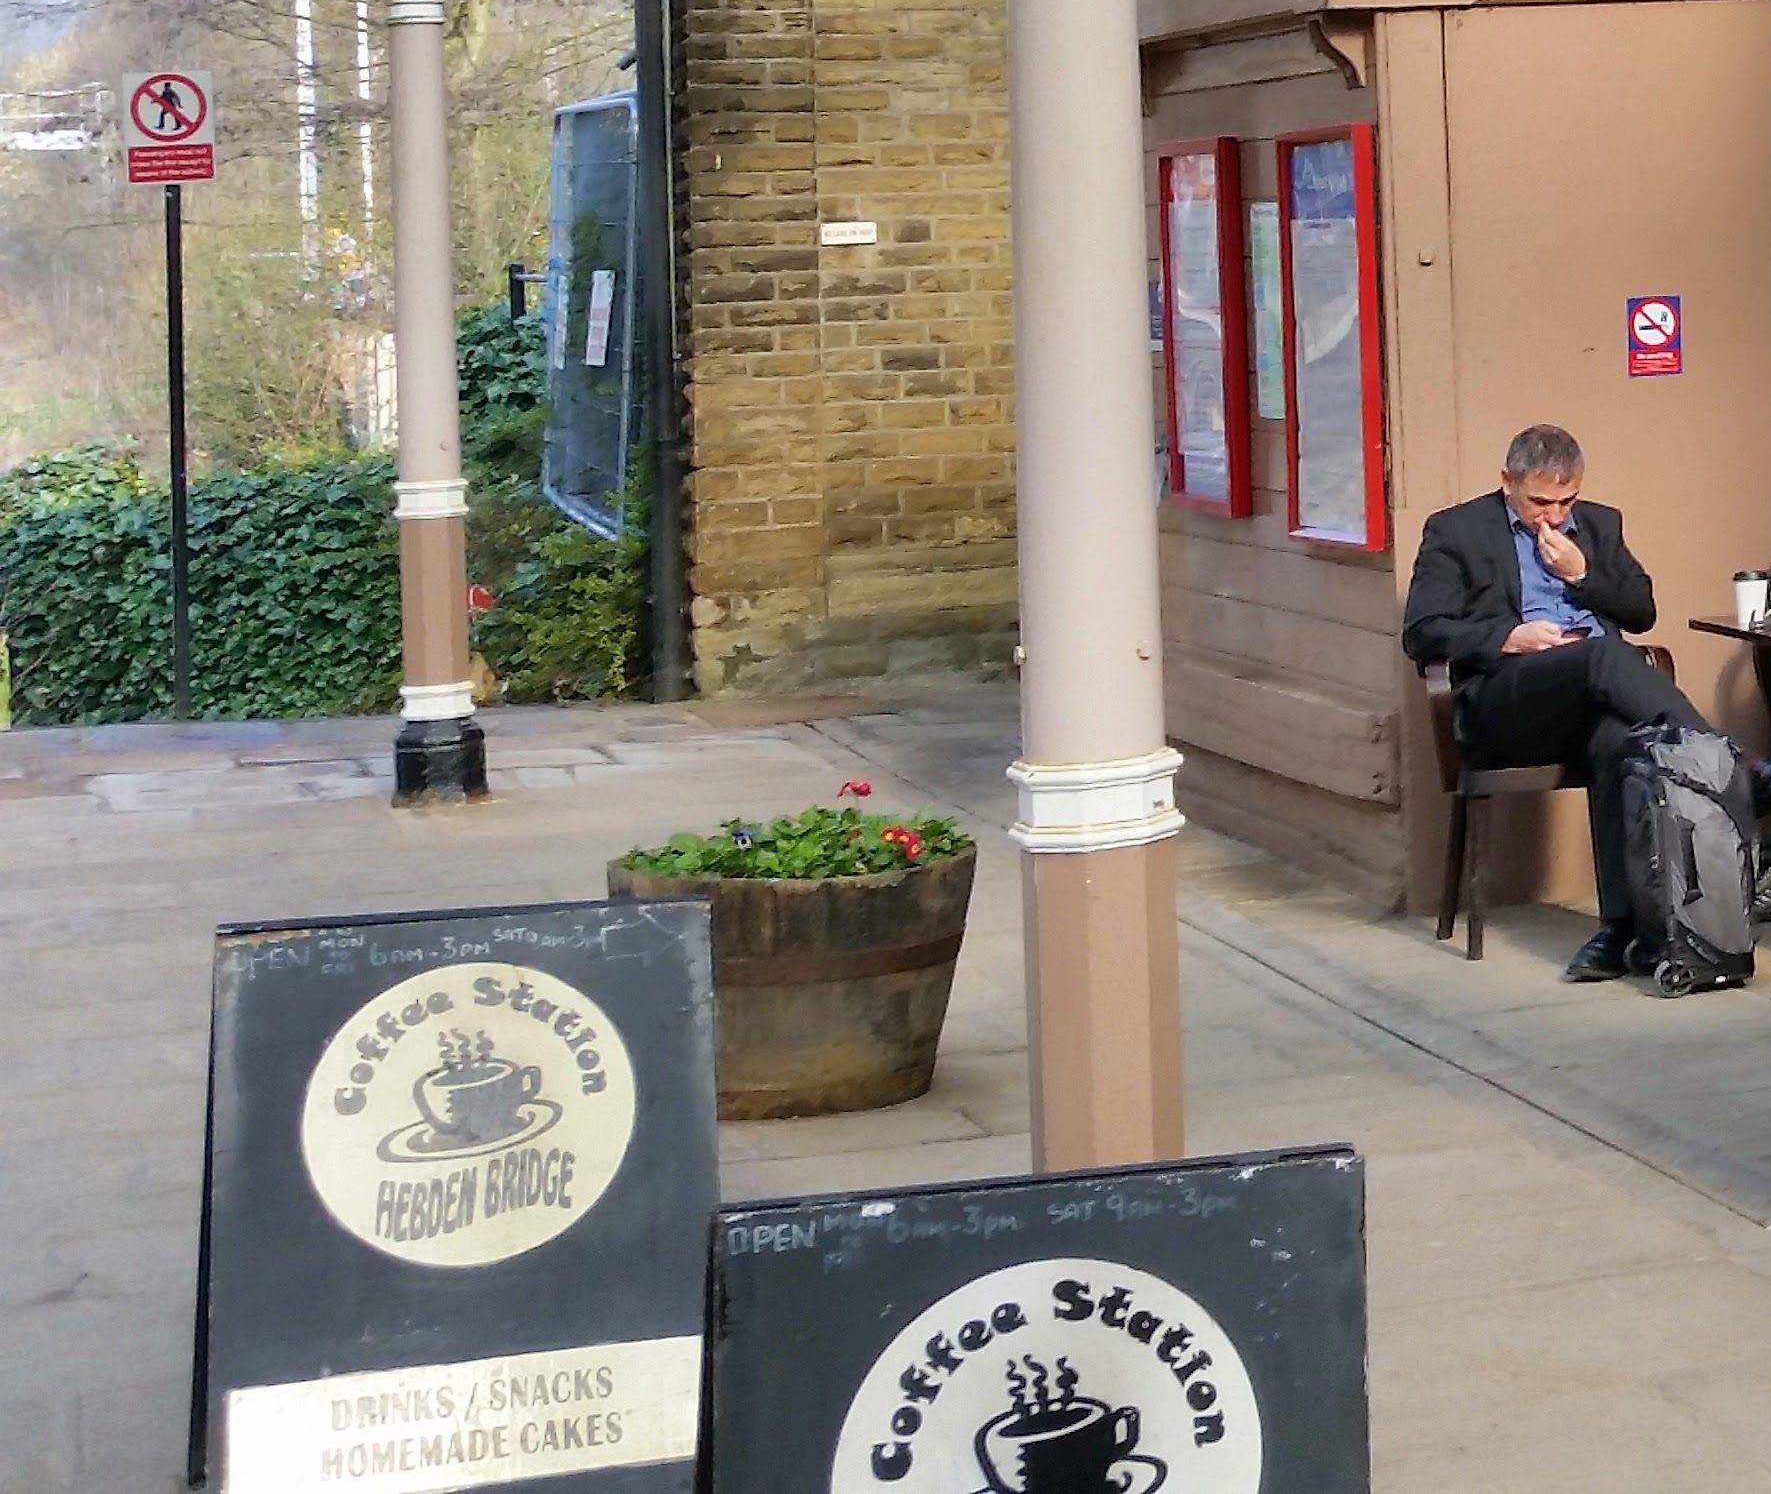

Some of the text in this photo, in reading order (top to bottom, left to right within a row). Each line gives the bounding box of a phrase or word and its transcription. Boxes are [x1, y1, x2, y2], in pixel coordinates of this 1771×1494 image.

[334, 976, 608, 1116] Coffee Station
[375, 1147, 576, 1243] HEBDEN BRIDGE
[727, 1220, 817, 1255] OPEN
[330, 1384, 454, 1434] DRINKS
[488, 1365, 615, 1412] SNACKS
[870, 1278, 1227, 1482] Coffee Station
[320, 1410, 625, 1483] HOMEMADE CAKES
